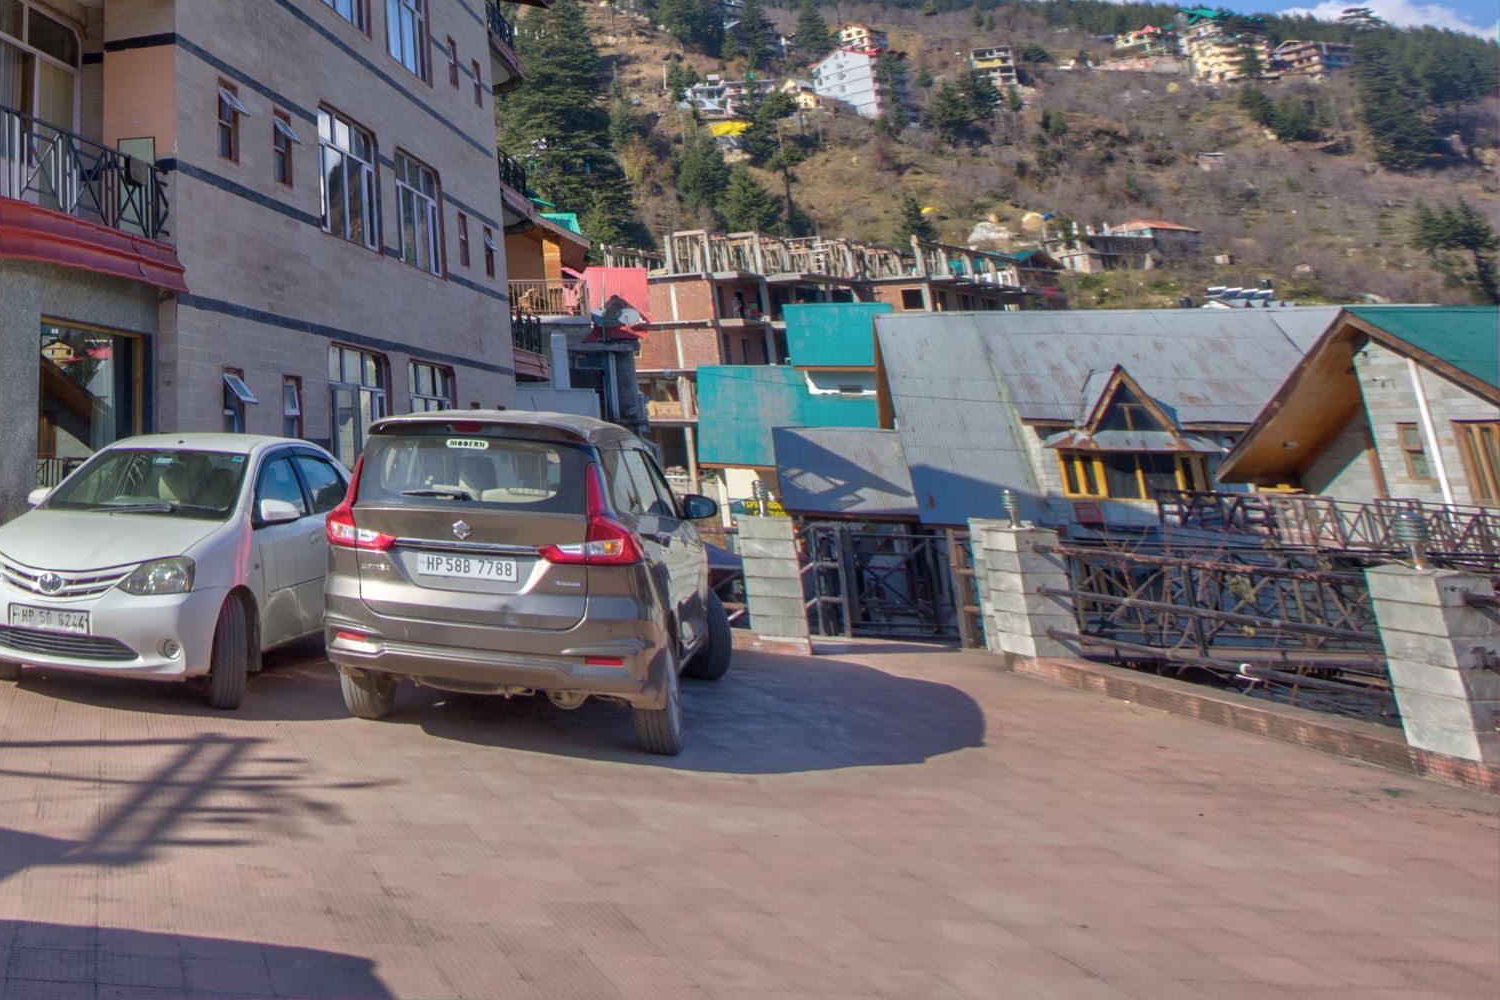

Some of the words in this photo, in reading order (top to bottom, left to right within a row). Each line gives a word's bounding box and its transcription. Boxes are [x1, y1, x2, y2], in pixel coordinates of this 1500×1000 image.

[450, 440, 485, 448] MODERN
[427, 556, 443, 571] HP
[446, 558, 471, 574] 58B
[478, 559, 512, 577] 7788
[21, 609, 34, 622] HP
